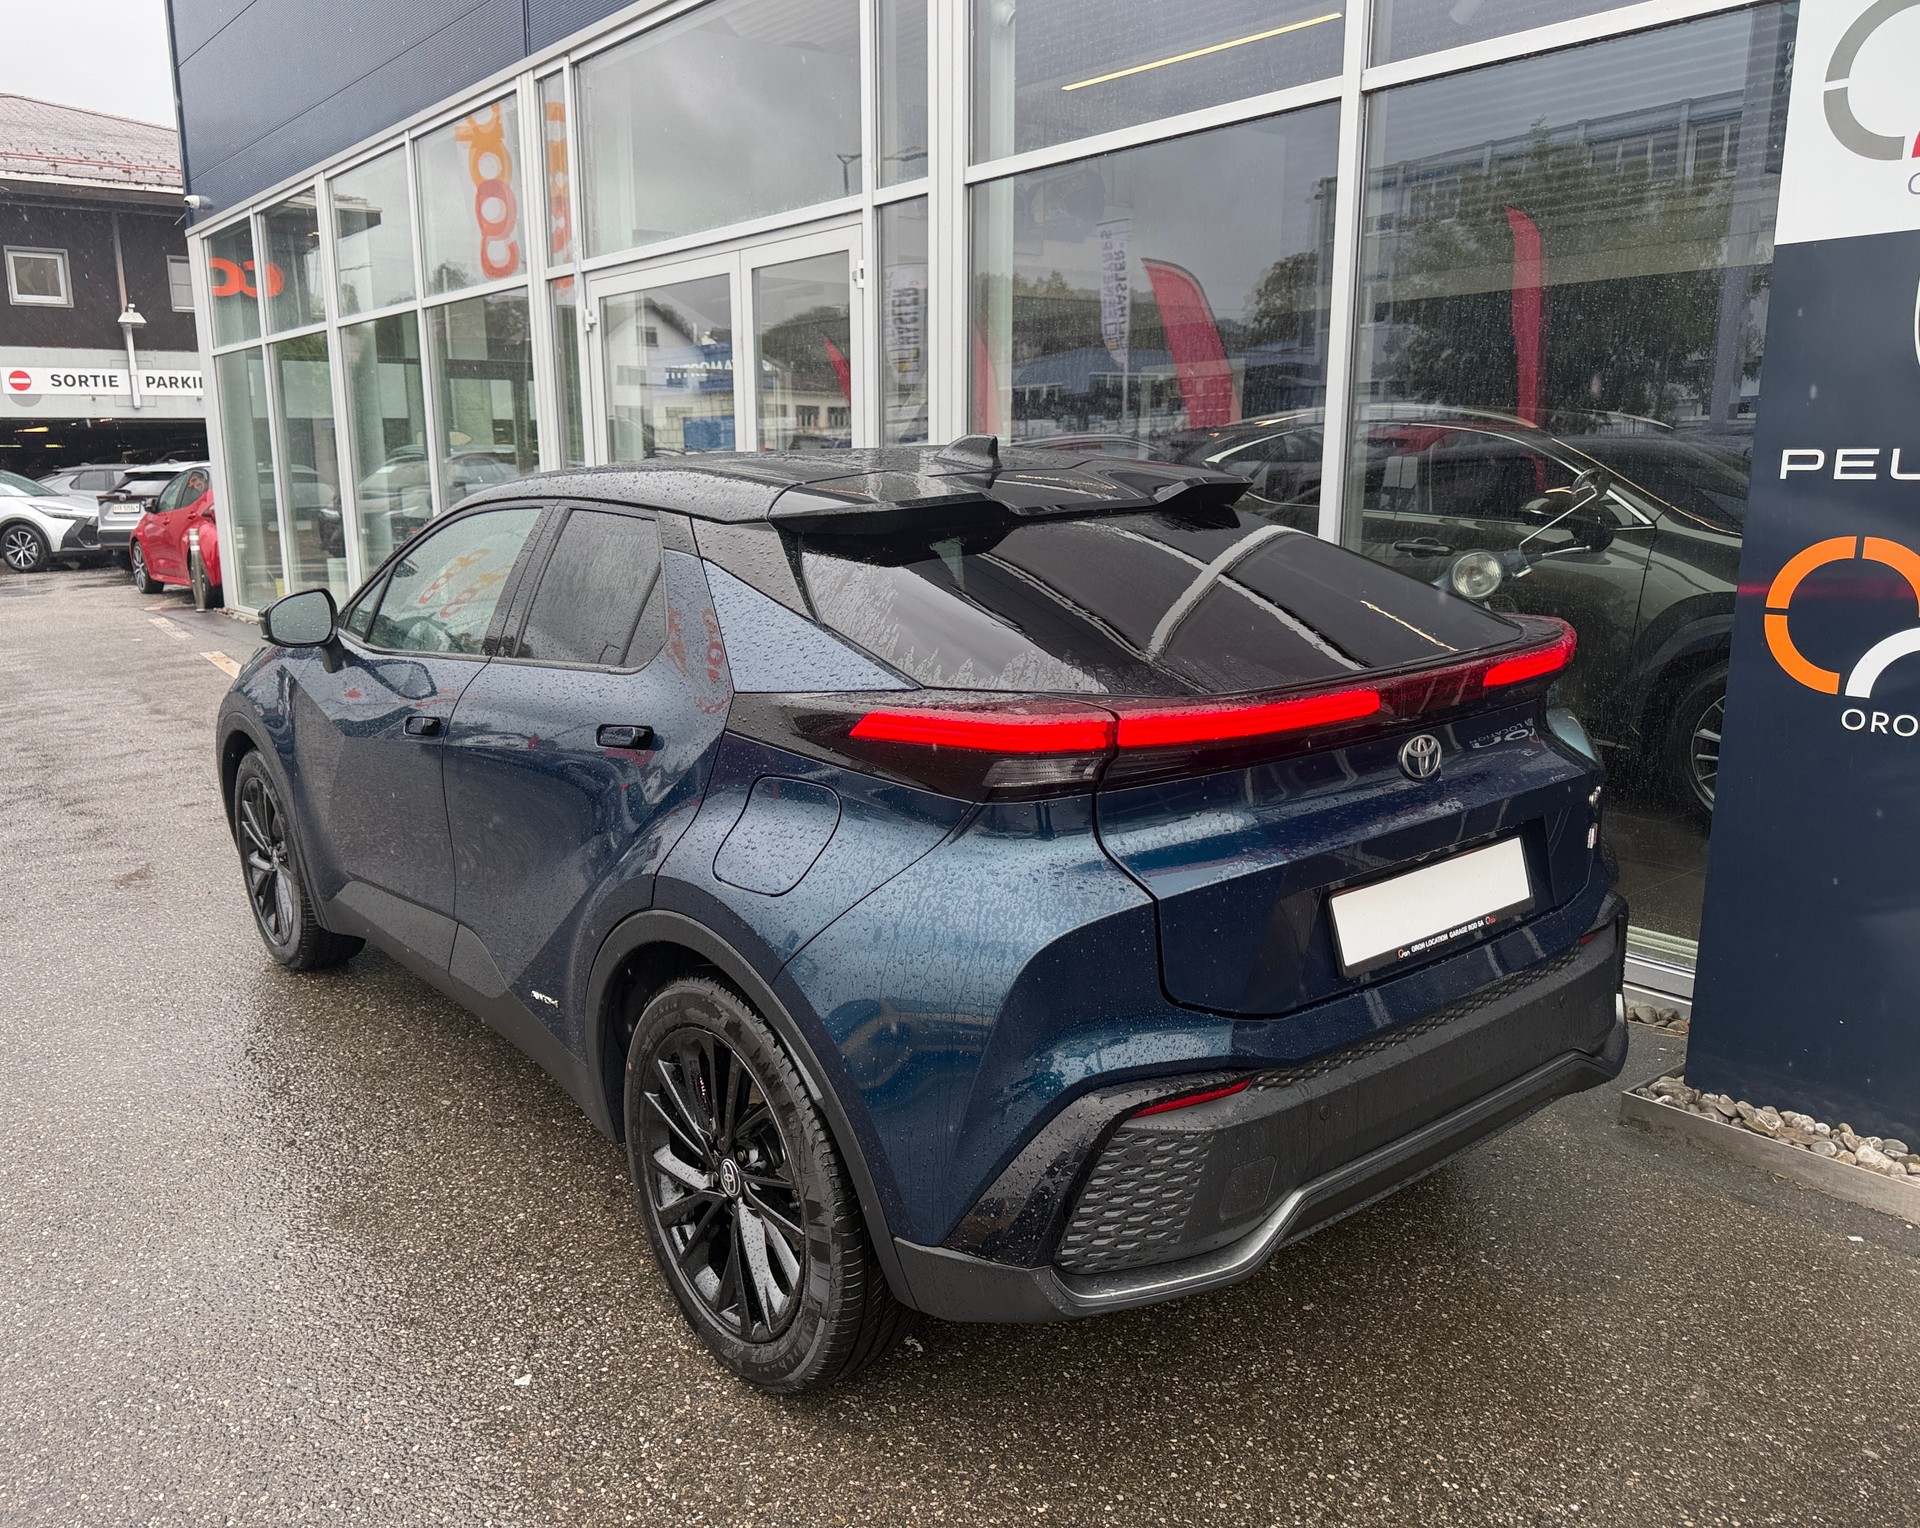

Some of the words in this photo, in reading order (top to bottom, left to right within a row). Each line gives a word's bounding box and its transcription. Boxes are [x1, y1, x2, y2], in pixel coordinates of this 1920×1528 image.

[50, 373, 120, 388] SORTIE
[1411, 942, 1426, 952] ORON
[1425, 933, 1448, 947] LOCATION
[1449, 926, 1468, 938] GARAGE
